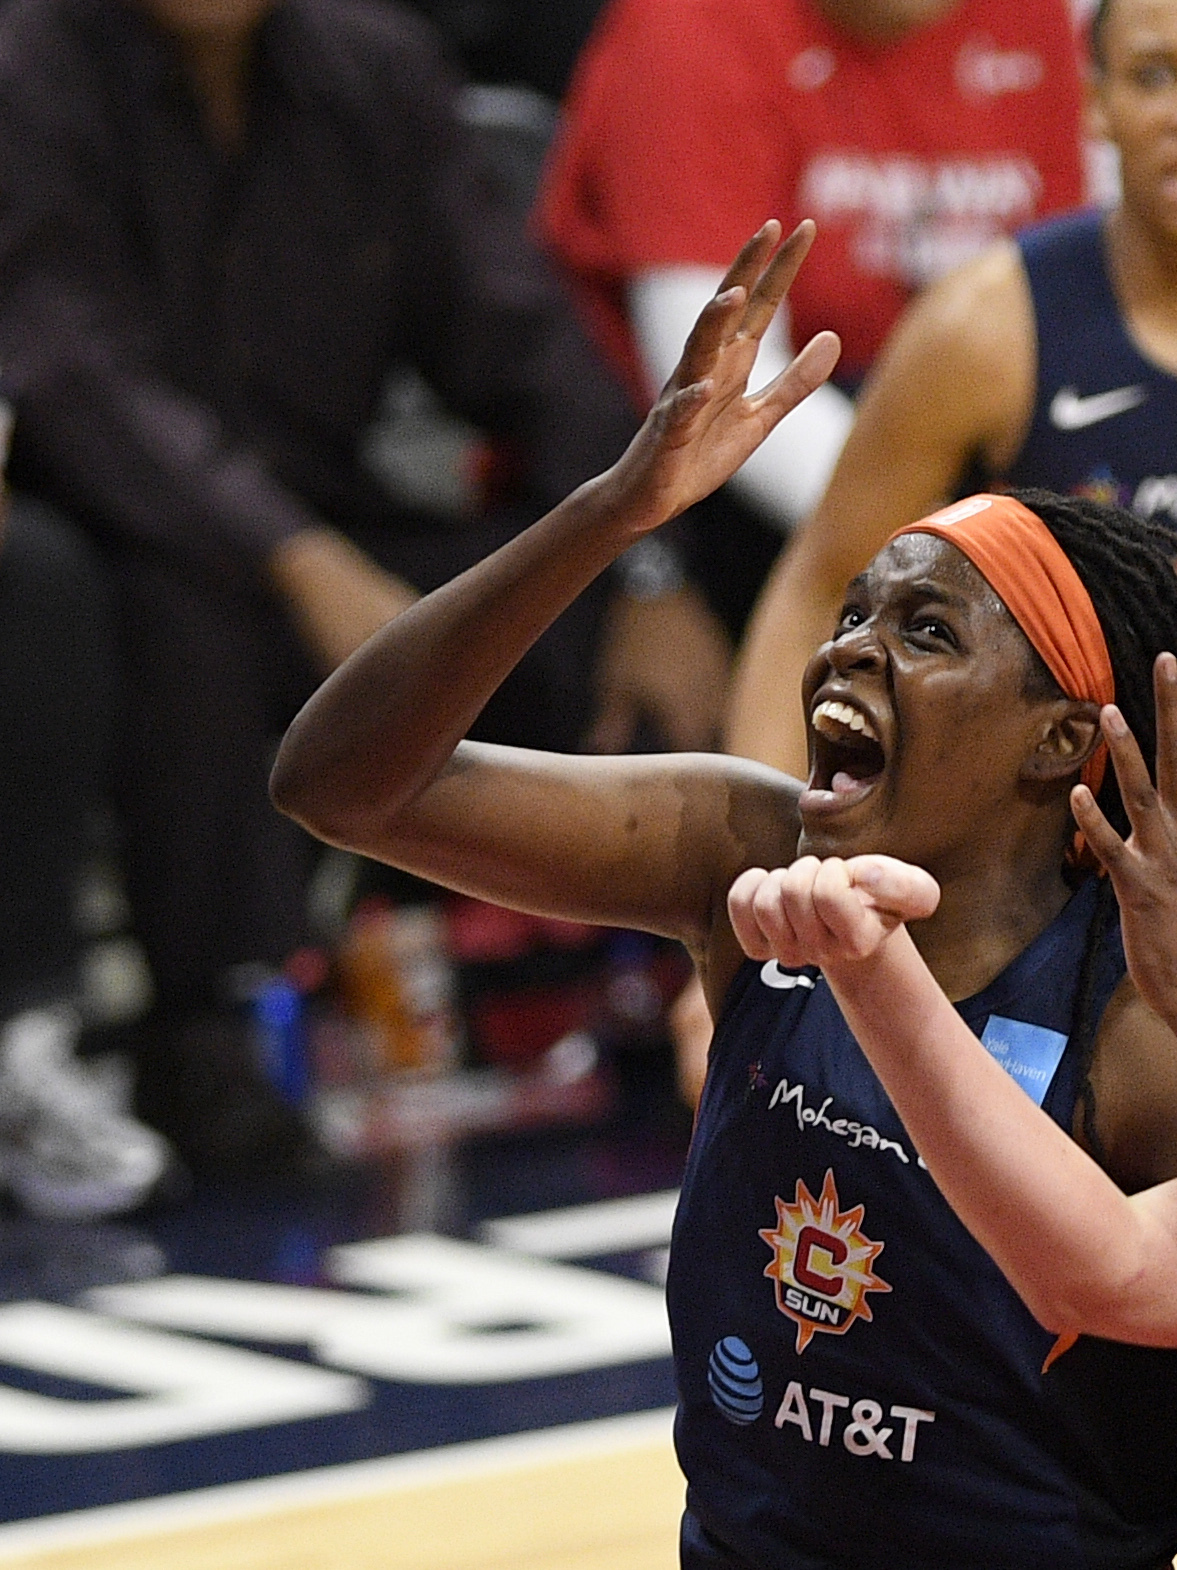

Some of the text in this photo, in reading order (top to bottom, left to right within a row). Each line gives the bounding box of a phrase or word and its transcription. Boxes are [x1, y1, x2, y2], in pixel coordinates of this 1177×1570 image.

[768, 1078, 909, 1164] Mohegan
[784, 1288, 840, 1325] SUN
[774, 1380, 936, 1462] AT&T
